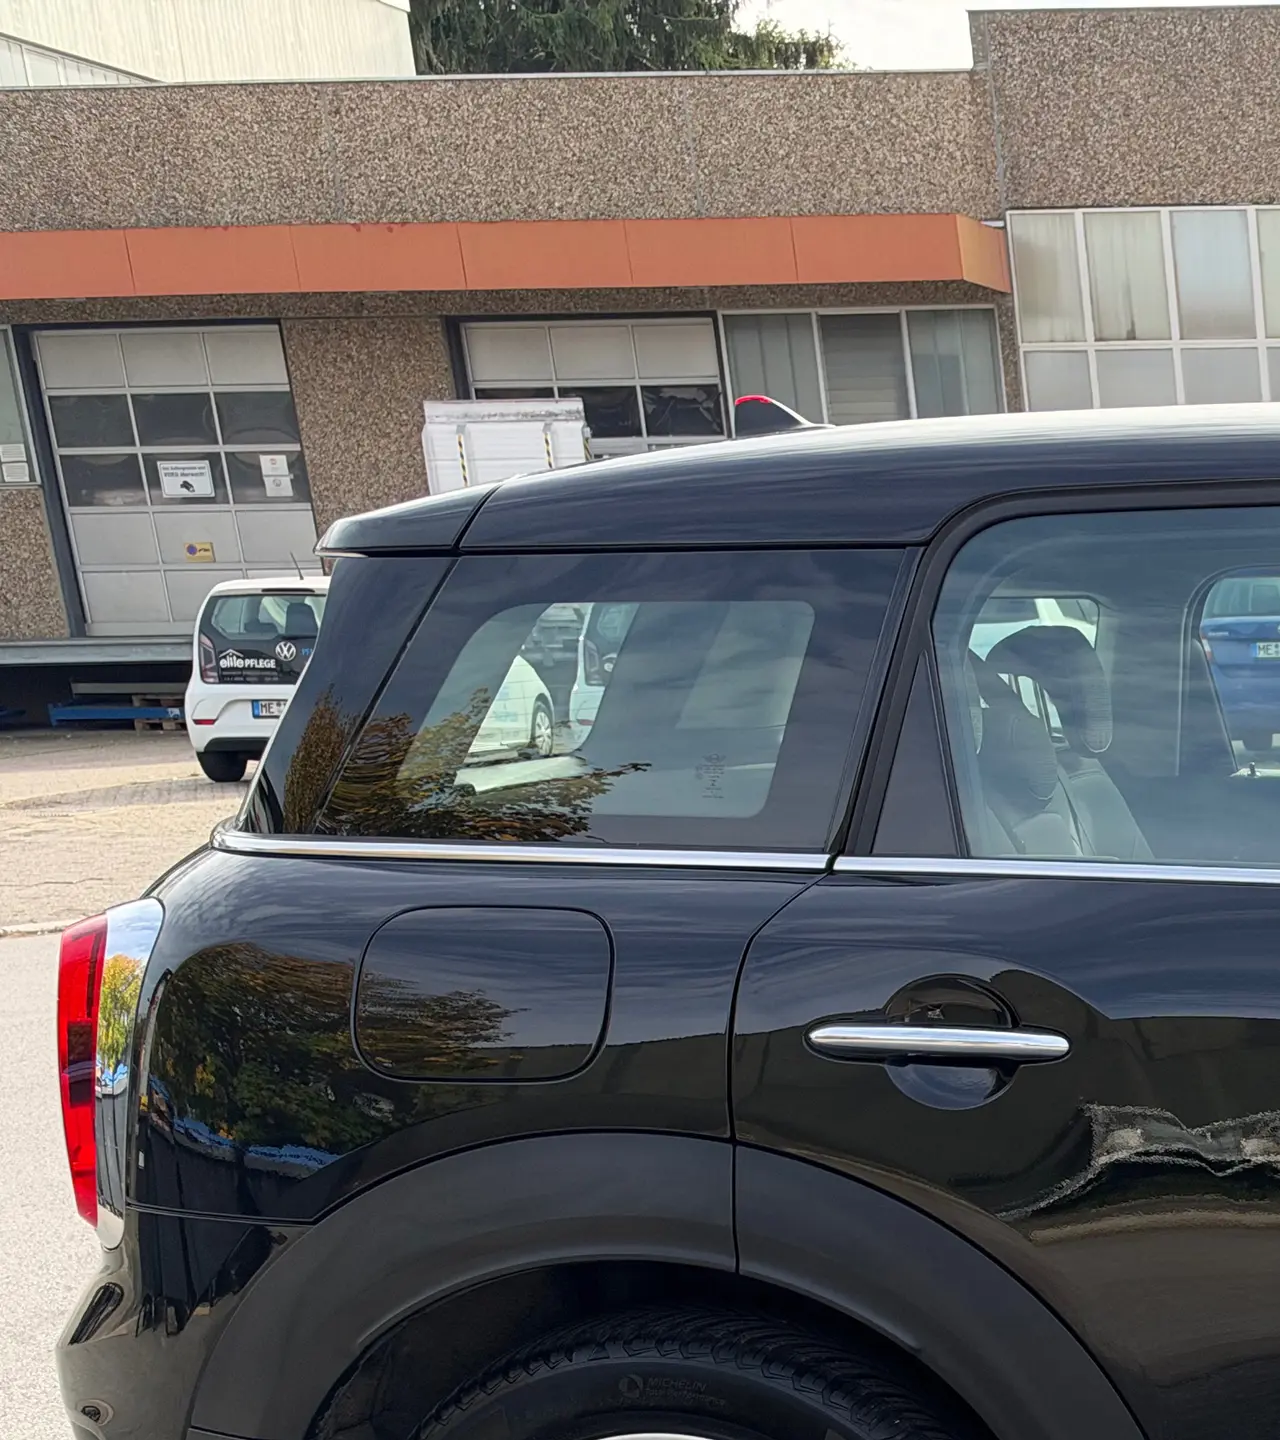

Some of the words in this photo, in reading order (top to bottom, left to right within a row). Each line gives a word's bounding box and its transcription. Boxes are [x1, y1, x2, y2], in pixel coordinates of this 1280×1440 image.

[1257, 644, 1273, 656] ME
[244, 658, 276, 669] PFLEGE
[260, 702, 275, 715] ME
